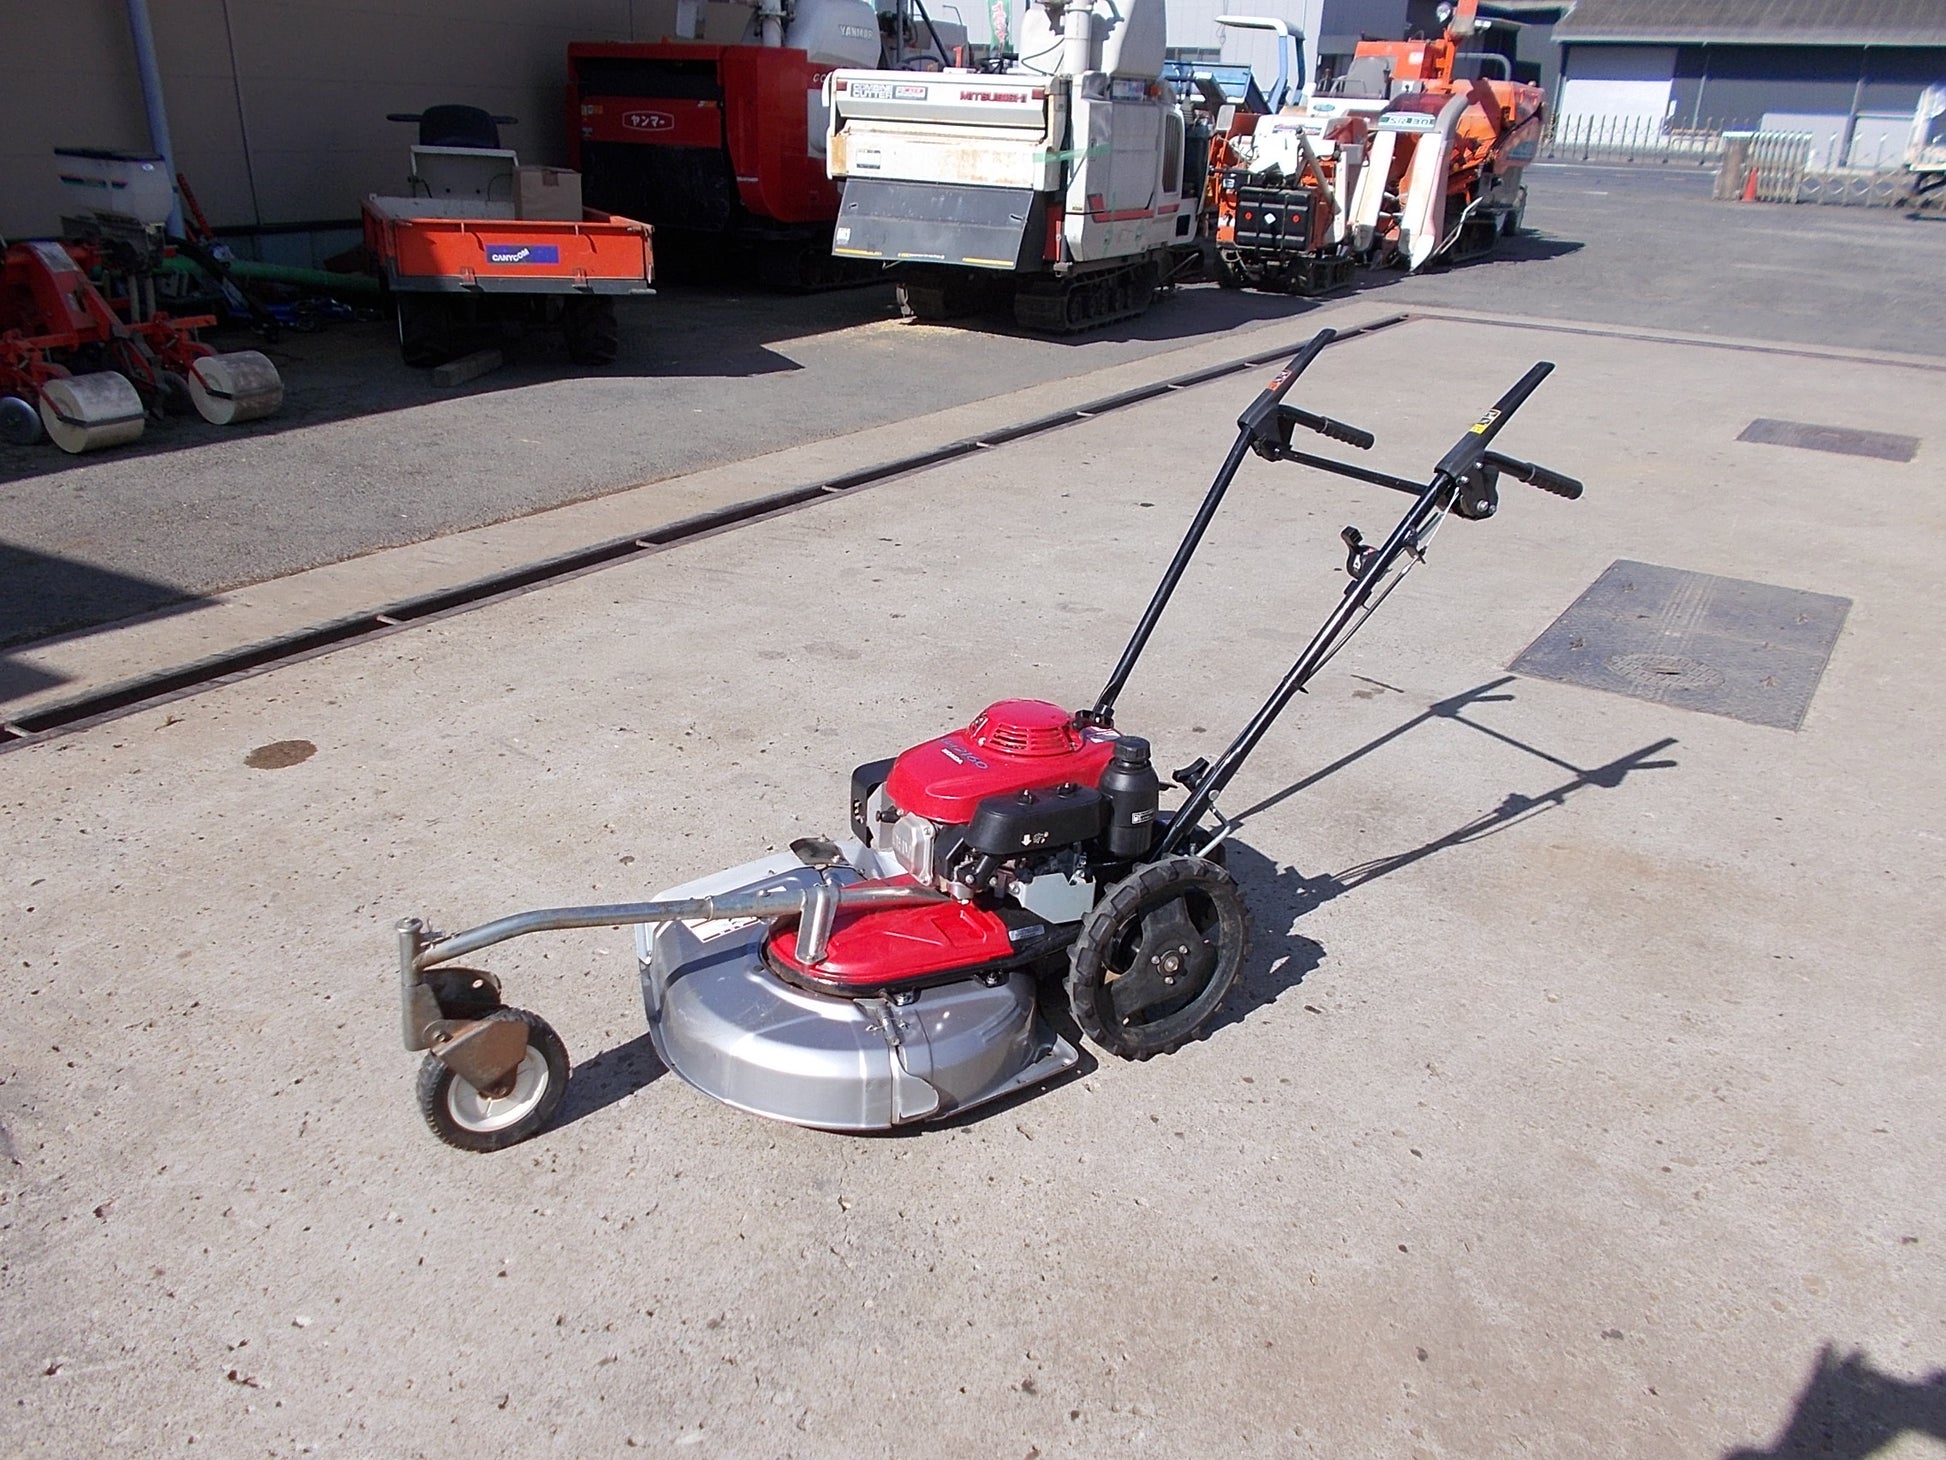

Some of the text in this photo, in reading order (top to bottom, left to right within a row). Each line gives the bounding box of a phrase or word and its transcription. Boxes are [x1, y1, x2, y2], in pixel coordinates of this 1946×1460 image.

[852, 90, 893, 99] CUTTER
[960, 91, 1027, 103] MITSUBISHI
[631, 114, 665, 127] ヤンマー
[491, 248, 530, 262] CANYCOM
[941, 748, 963, 765] HONDA
